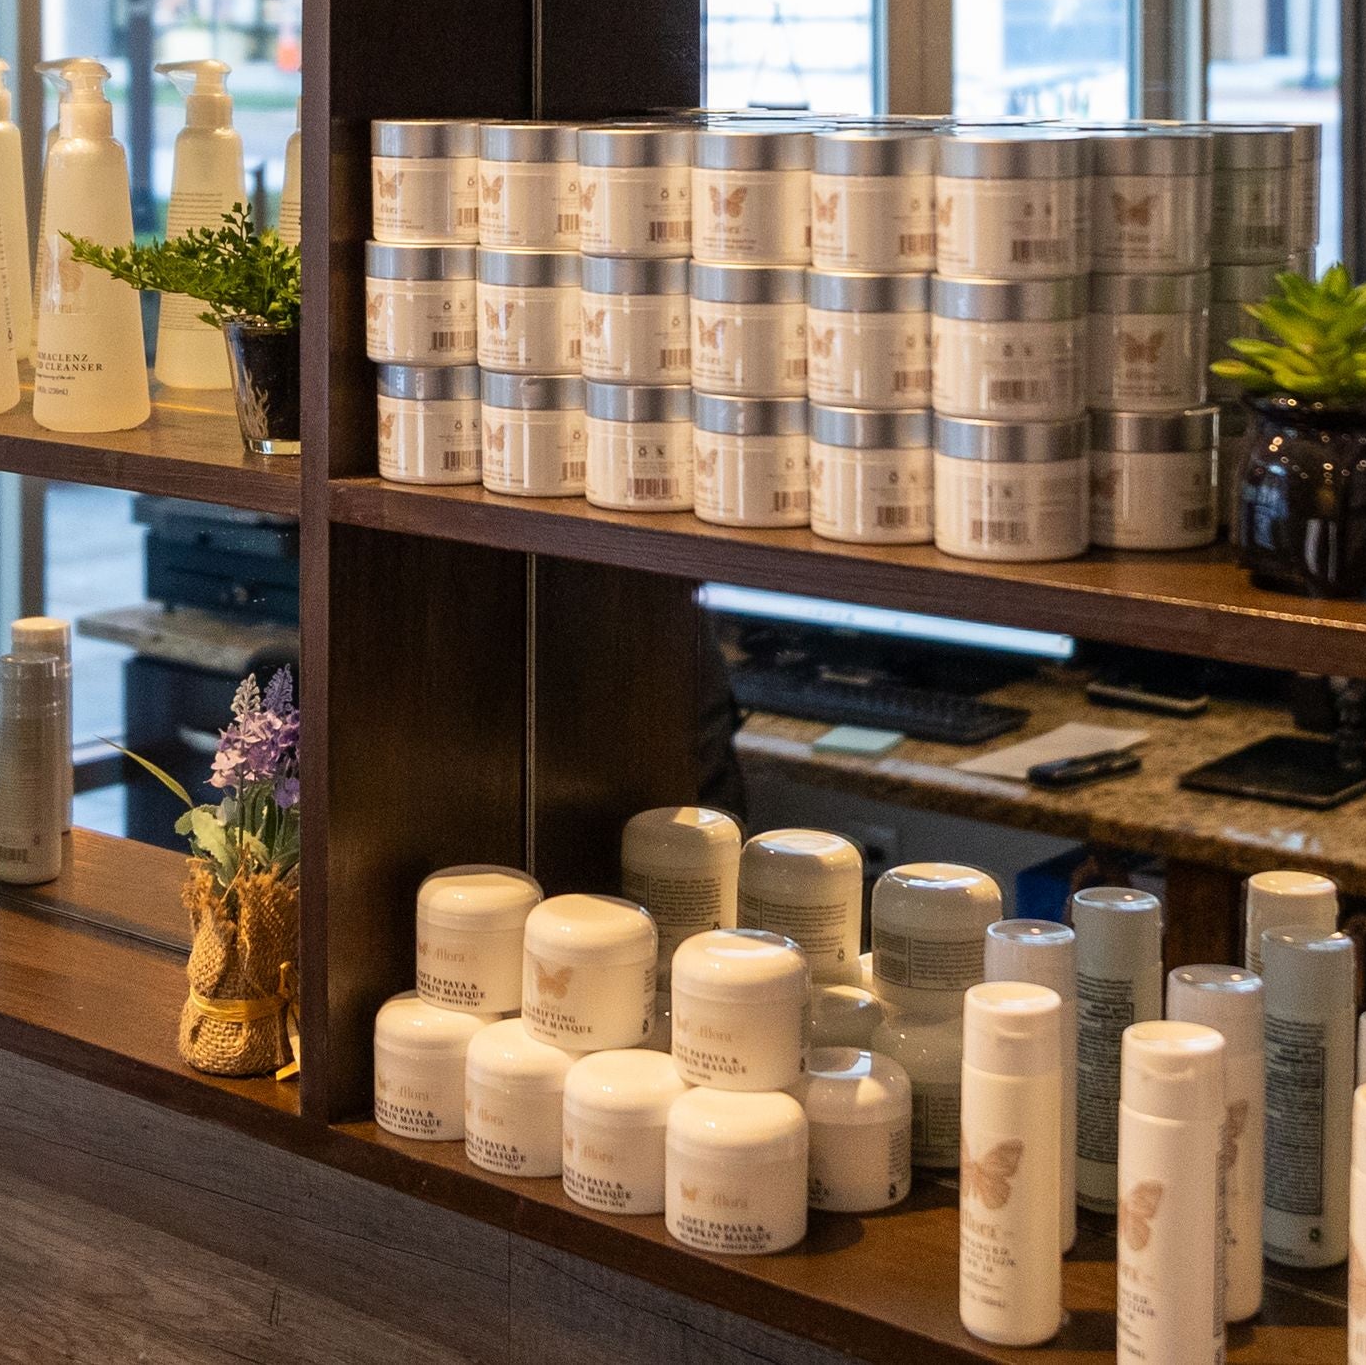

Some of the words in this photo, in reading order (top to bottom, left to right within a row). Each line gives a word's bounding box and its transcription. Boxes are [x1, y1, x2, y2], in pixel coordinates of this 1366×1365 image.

[44, 362, 104, 372] CLEANSER
[432, 976, 467, 990] PAPAYA
[443, 986, 486, 1000] MASQUE
[702, 1062, 747, 1076] MASQUE
[390, 1103, 423, 1118] PAPAYA
[400, 1116, 443, 1128] MASQUE
[484, 1148, 527, 1163] MASQUE
[588, 1186, 632, 1200] MASQUE
